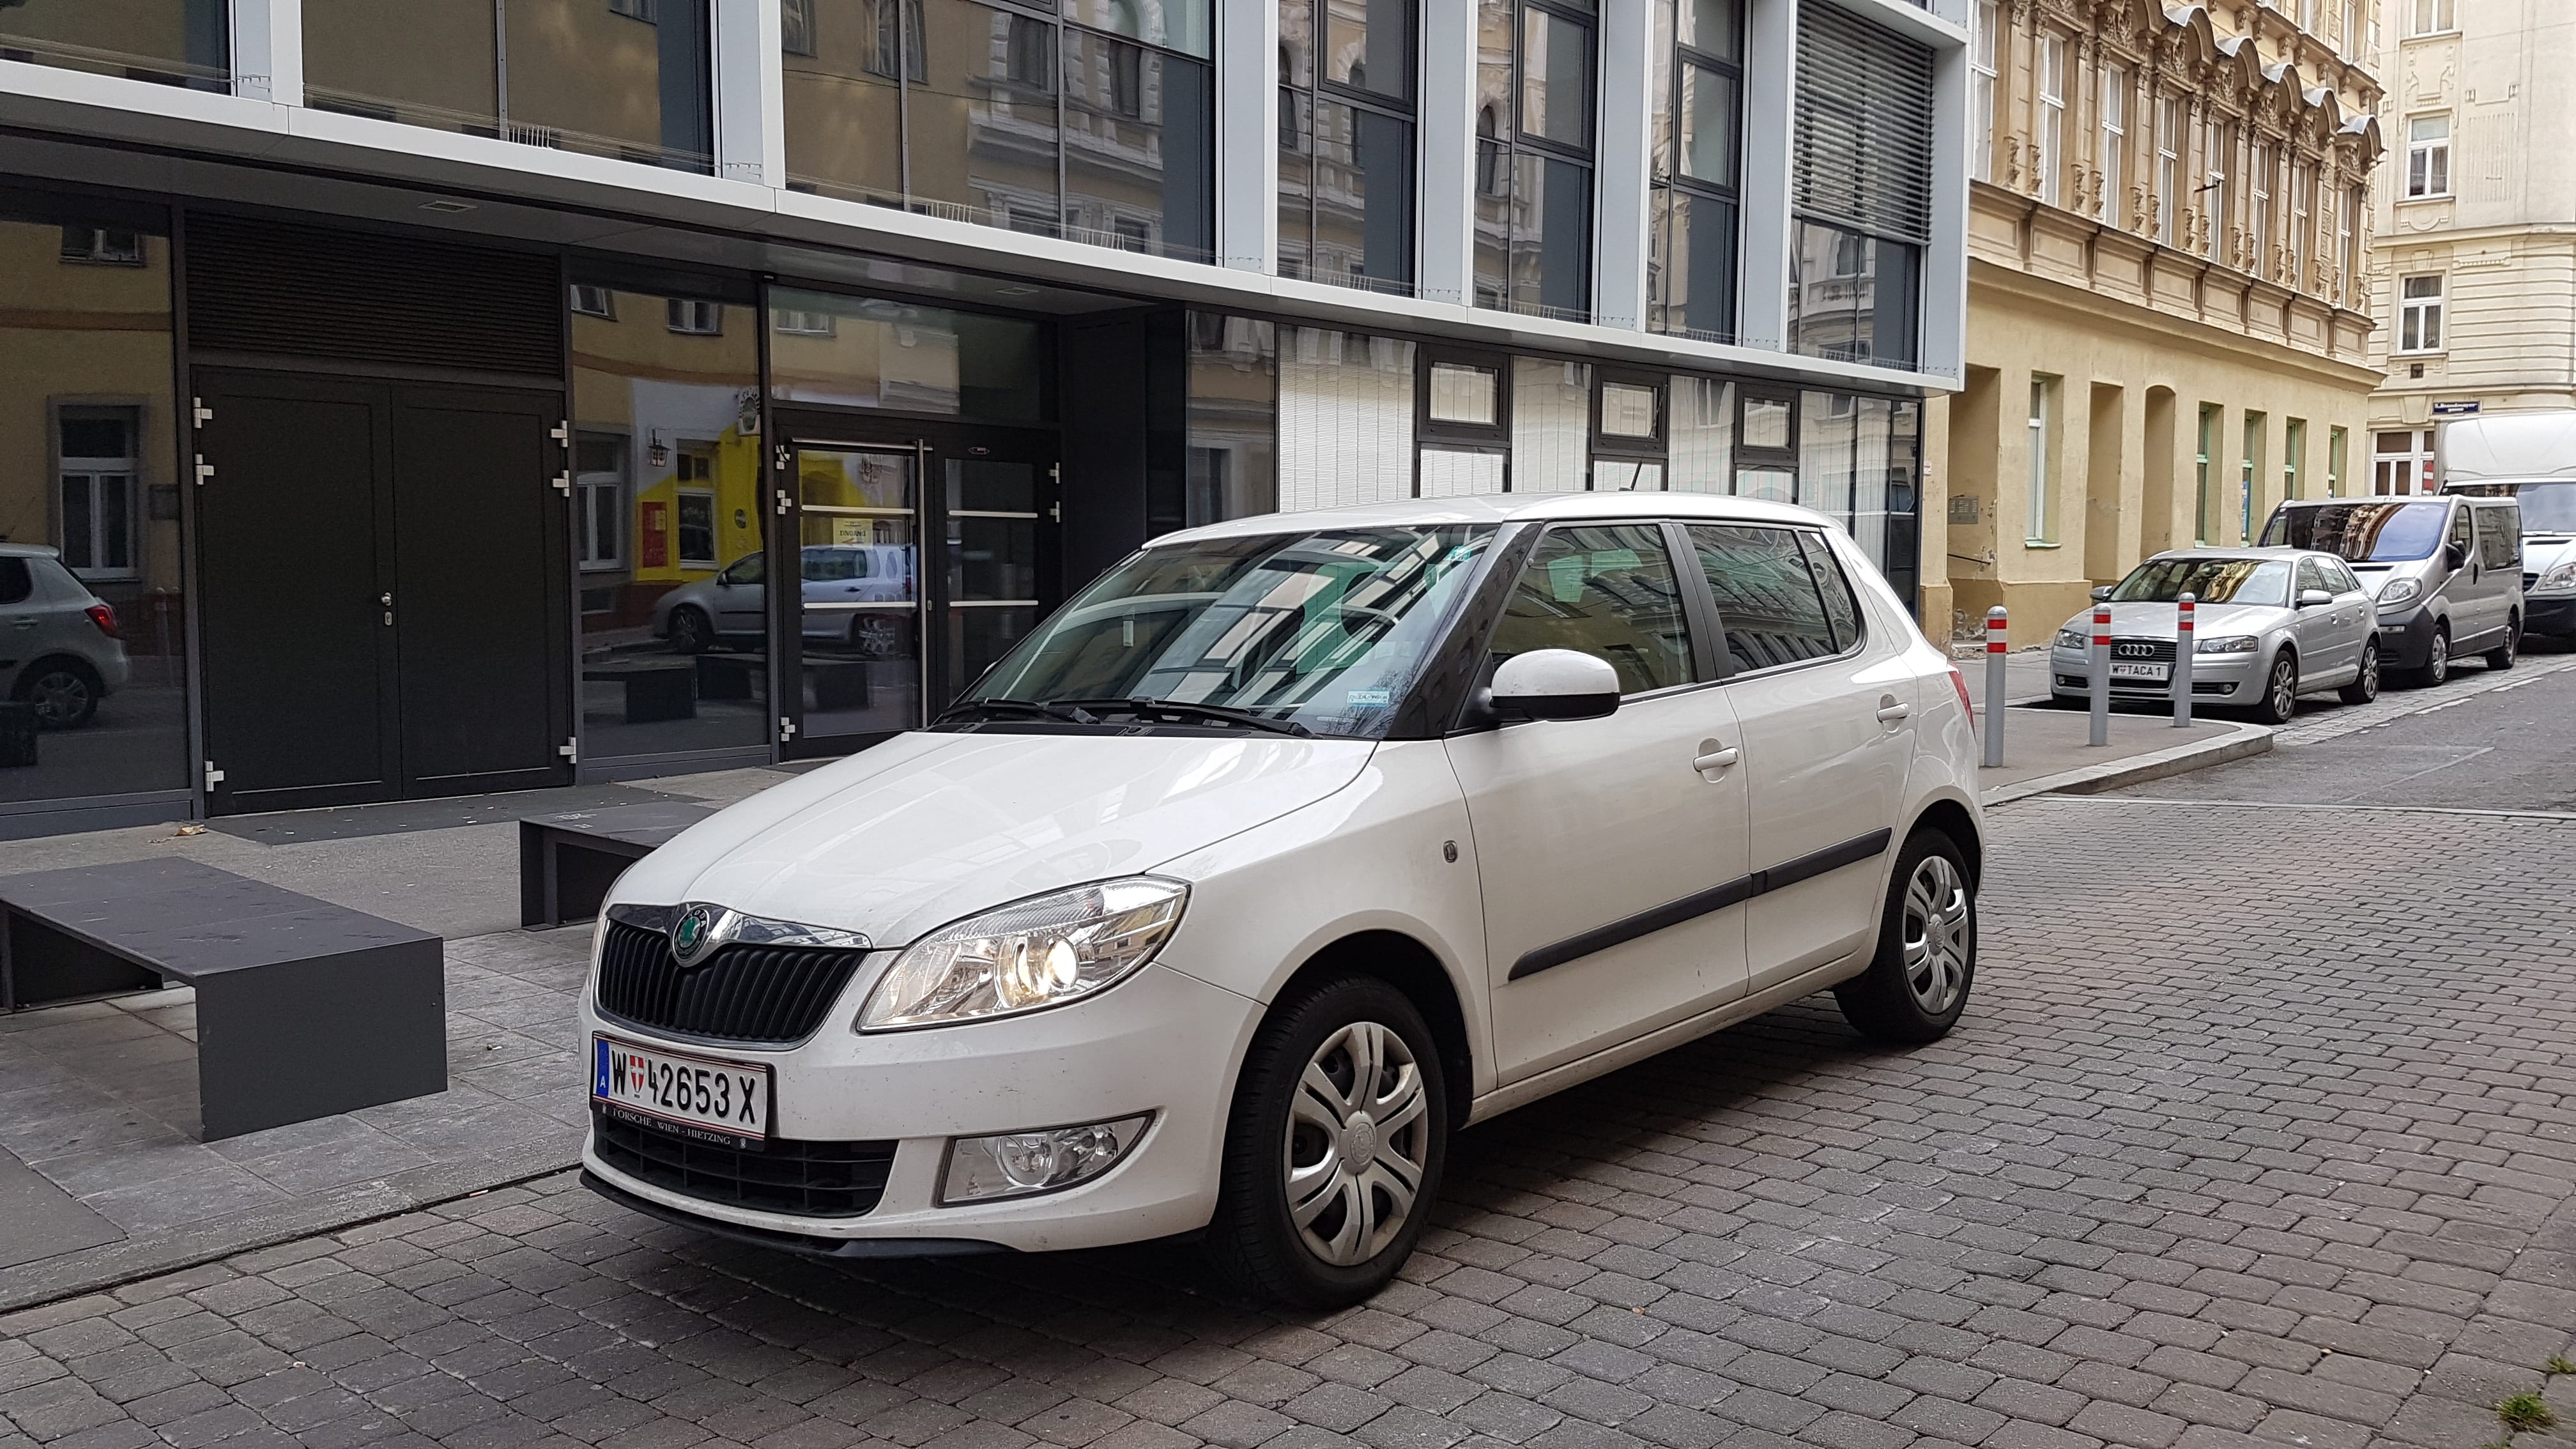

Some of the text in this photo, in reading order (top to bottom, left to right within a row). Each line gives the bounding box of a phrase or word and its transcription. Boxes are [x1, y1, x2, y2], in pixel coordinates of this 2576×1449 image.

[2112, 664, 2161, 676] W TACA 1
[600, 1075, 606, 1088] A
[611, 1050, 755, 1124] W 42653 X
[657, 1121, 679, 1133] WIEN
[687, 1128, 731, 1145] HIETZING
